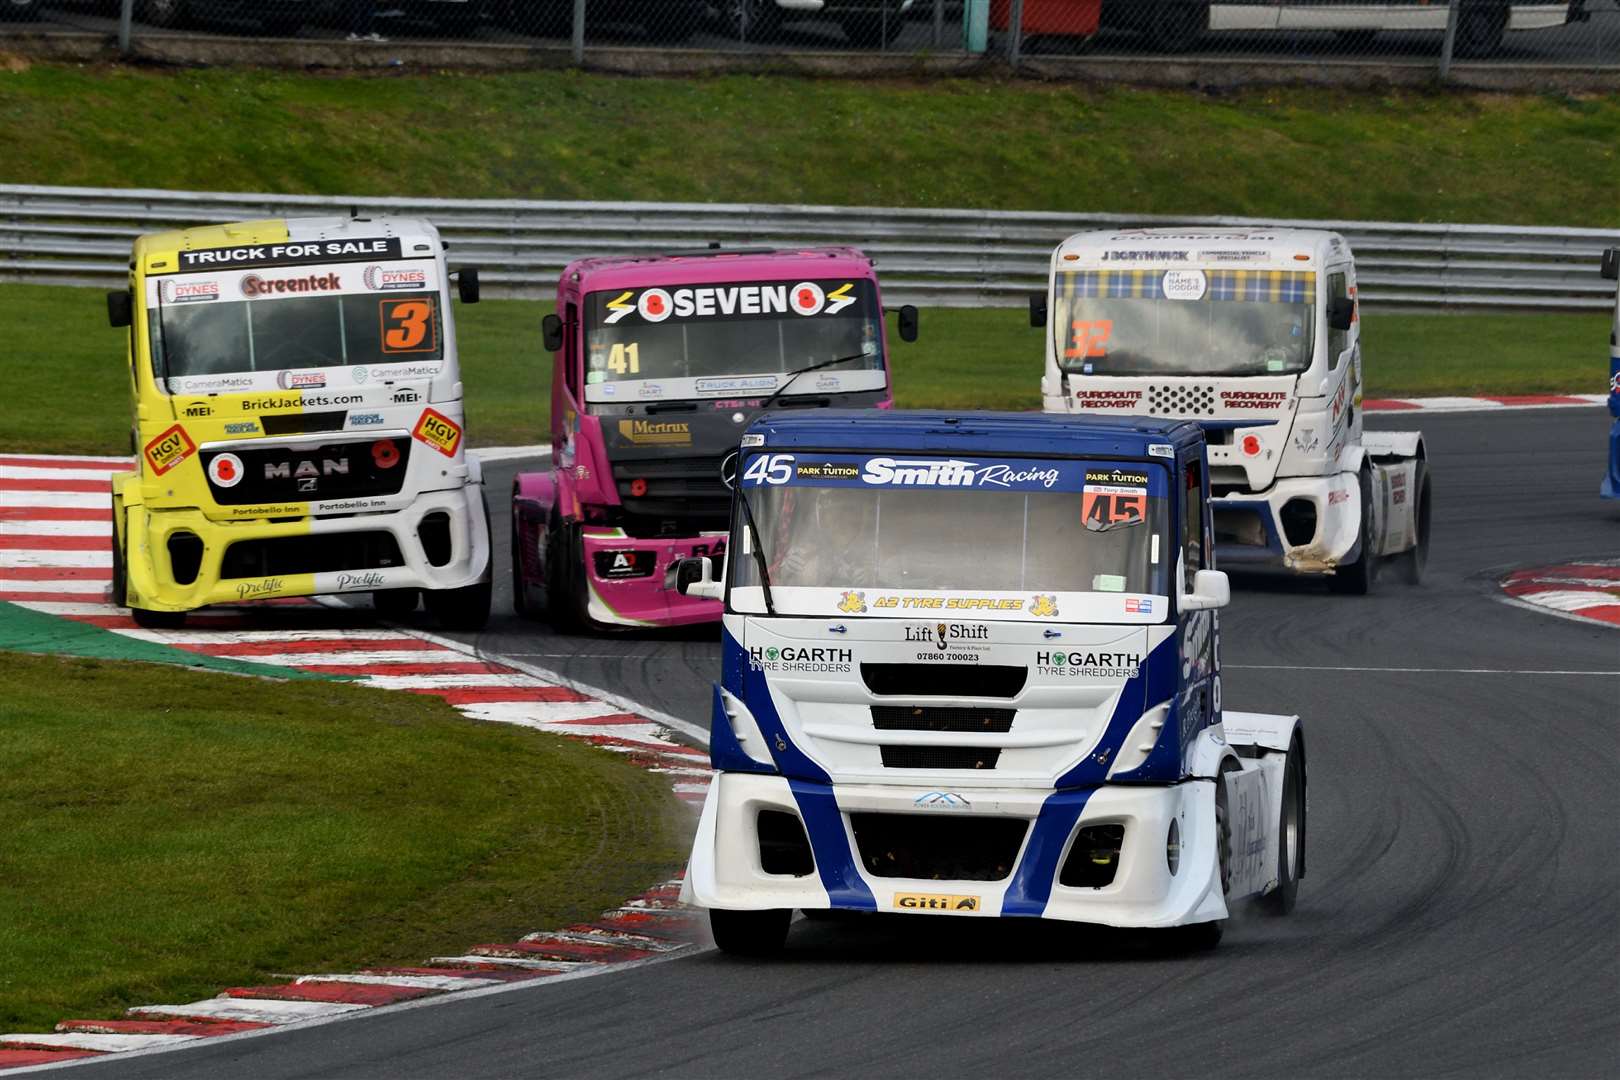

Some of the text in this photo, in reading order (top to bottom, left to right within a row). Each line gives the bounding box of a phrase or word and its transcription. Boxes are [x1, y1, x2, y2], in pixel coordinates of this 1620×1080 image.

[184, 241, 388, 264] TRUCK FOR SALE
[245, 273, 341, 296] Screentek
[382, 272, 425, 282] DYNES
[175, 284, 219, 295] DYNES
[673, 286, 787, 316] SEVEN
[386, 303, 431, 348] 3
[1065, 320, 1113, 357] 32
[608, 343, 640, 374] 41
[292, 374, 326, 384] DYNES
[371, 367, 439, 377] CameraMatics
[185, 378, 253, 389] CameraMatics
[242, 395, 363, 410] BrickJackets.com
[1081, 399, 1138, 408] RECOVERY
[1224, 400, 1282, 409] RECOVERY
[425, 417, 457, 441] HGV
[634, 420, 689, 433] Mertrux
[151, 434, 181, 461] HGV
[264, 458, 349, 479] MAN
[743, 455, 795, 484] 45
[862, 457, 1059, 488] Smith Racing
[1085, 473, 1148, 483] PARK TUITION
[233, 507, 282, 515] Portobello
[319, 502, 368, 511] Portobello
[1087, 495, 1140, 525] 45
[236, 579, 283, 598] Prolific
[336, 573, 385, 590] Prolific
[874, 597, 1024, 610] A2 TYRE SUPPLIES
[905, 624, 989, 641] Lift Shift
[750, 647, 852, 662] HOGARTH
[916, 653, 980, 661] 07860 700023
[1037, 652, 1139, 667] HOGARTH
[751, 662, 851, 672] TYRE SHREDDERS
[1037, 666, 1139, 678] TYRE SHREDDERS
[899, 897, 947, 909] Giti
